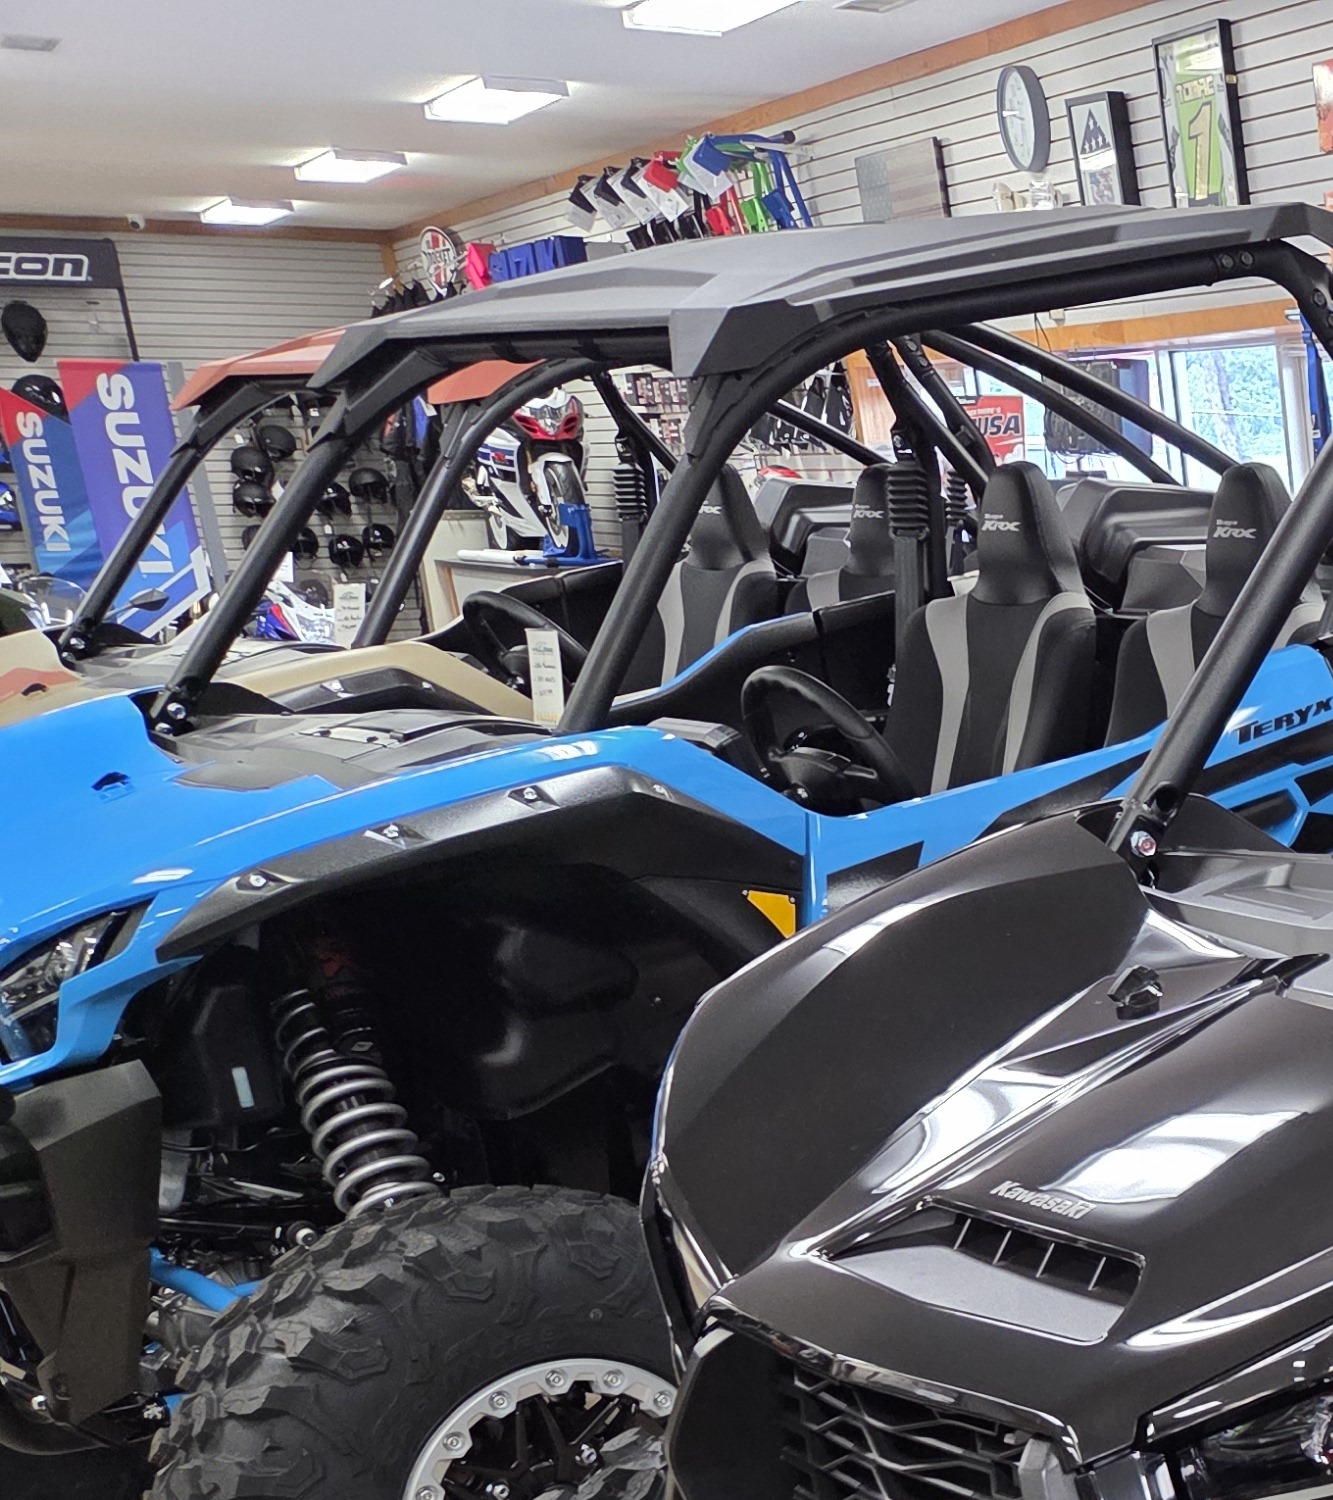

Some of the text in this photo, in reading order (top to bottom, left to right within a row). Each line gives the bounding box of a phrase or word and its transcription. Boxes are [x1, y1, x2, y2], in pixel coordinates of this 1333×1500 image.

[16, 411, 72, 552] SUZUKI
[981, 520, 1021, 532] KRX
[1213, 526, 1257, 539] KRX
[989, 1180, 1098, 1220] Kawasaki
